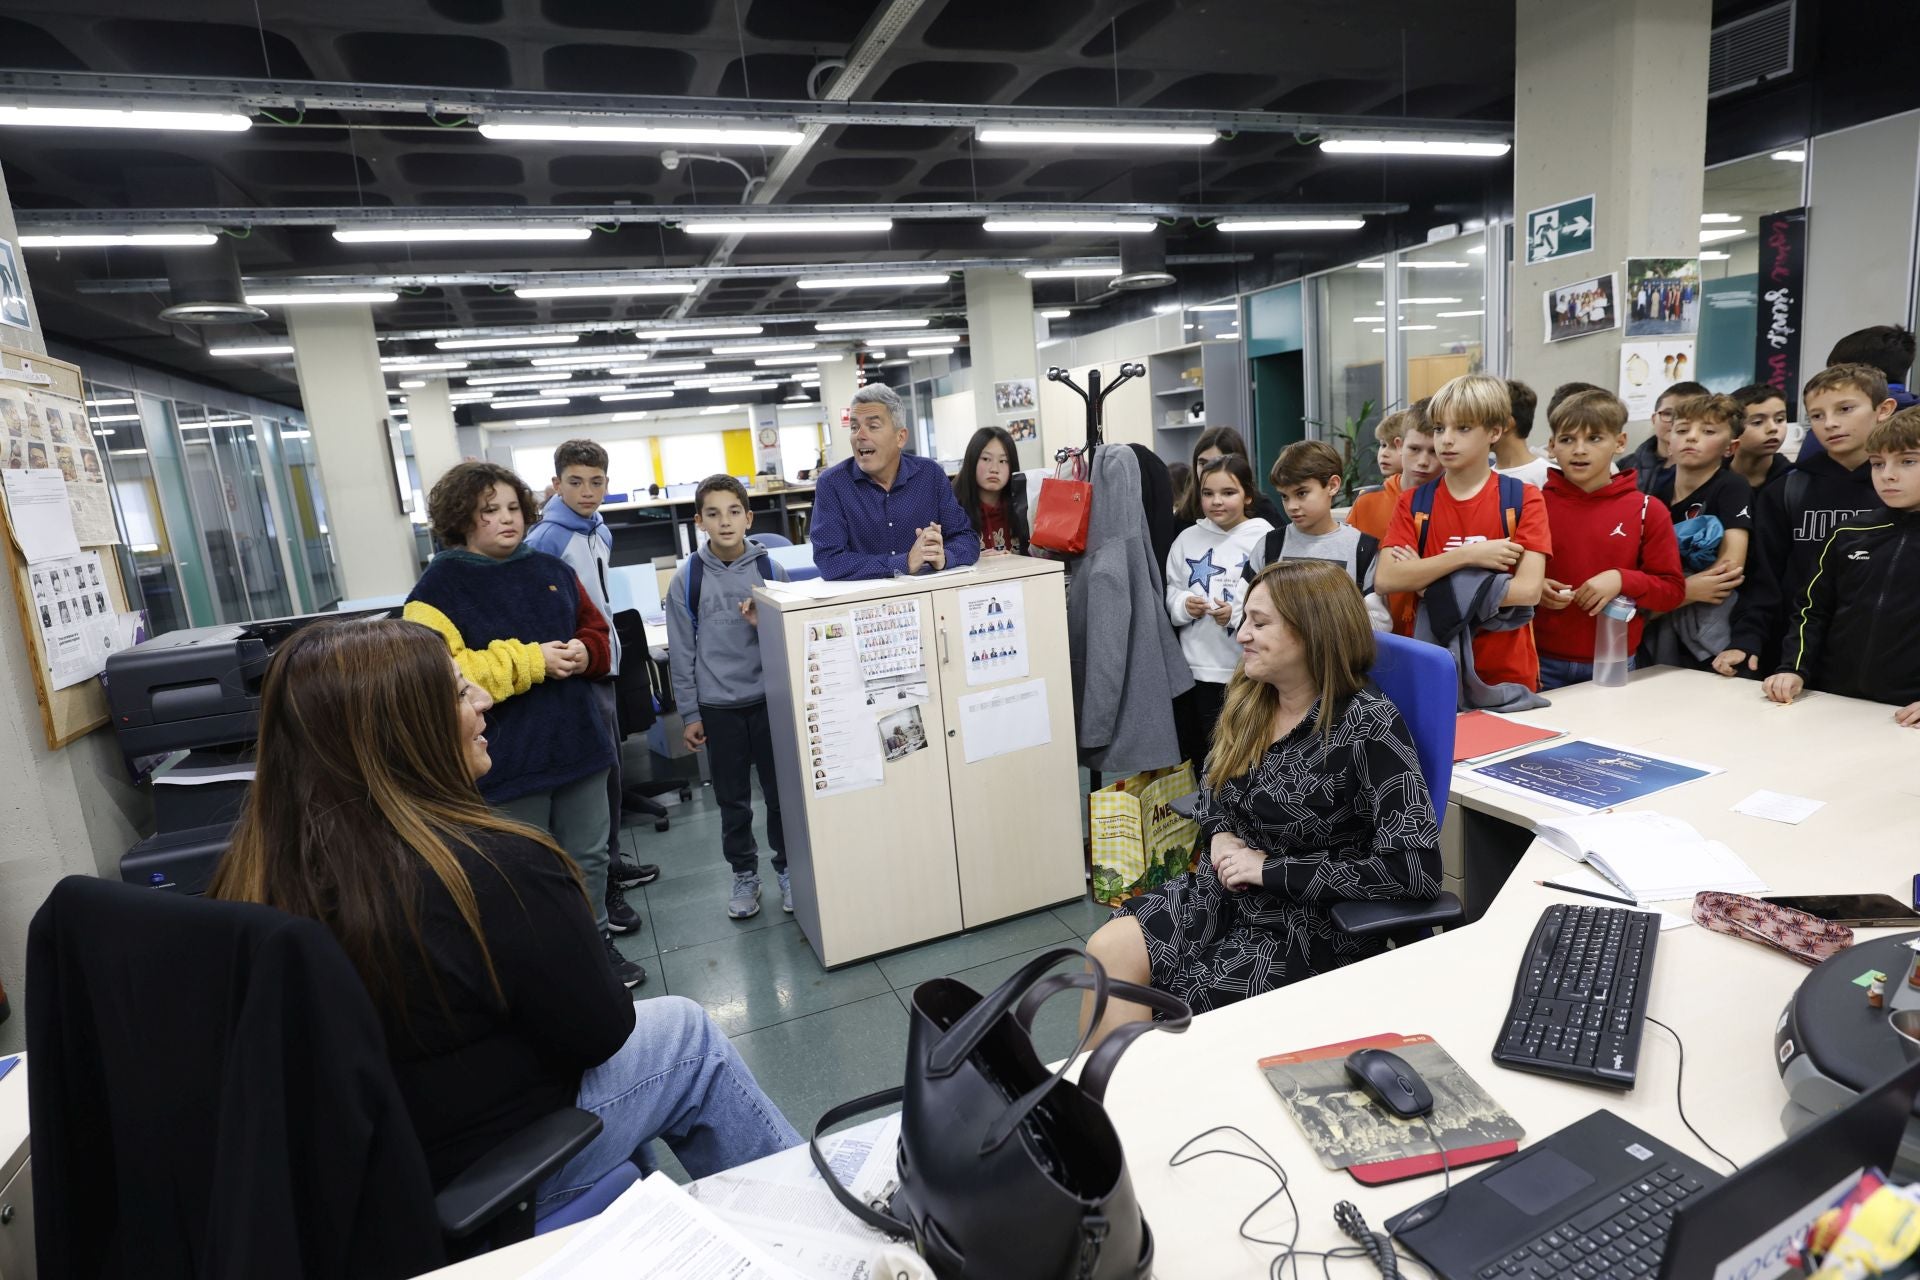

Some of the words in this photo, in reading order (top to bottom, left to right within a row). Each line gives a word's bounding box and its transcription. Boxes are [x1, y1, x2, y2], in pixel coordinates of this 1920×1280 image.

[1764, 287, 1795, 349] siente
[1767, 353, 1792, 391] viv
[1793, 509, 1873, 541] JO
[1152, 803, 1172, 826] ANE
